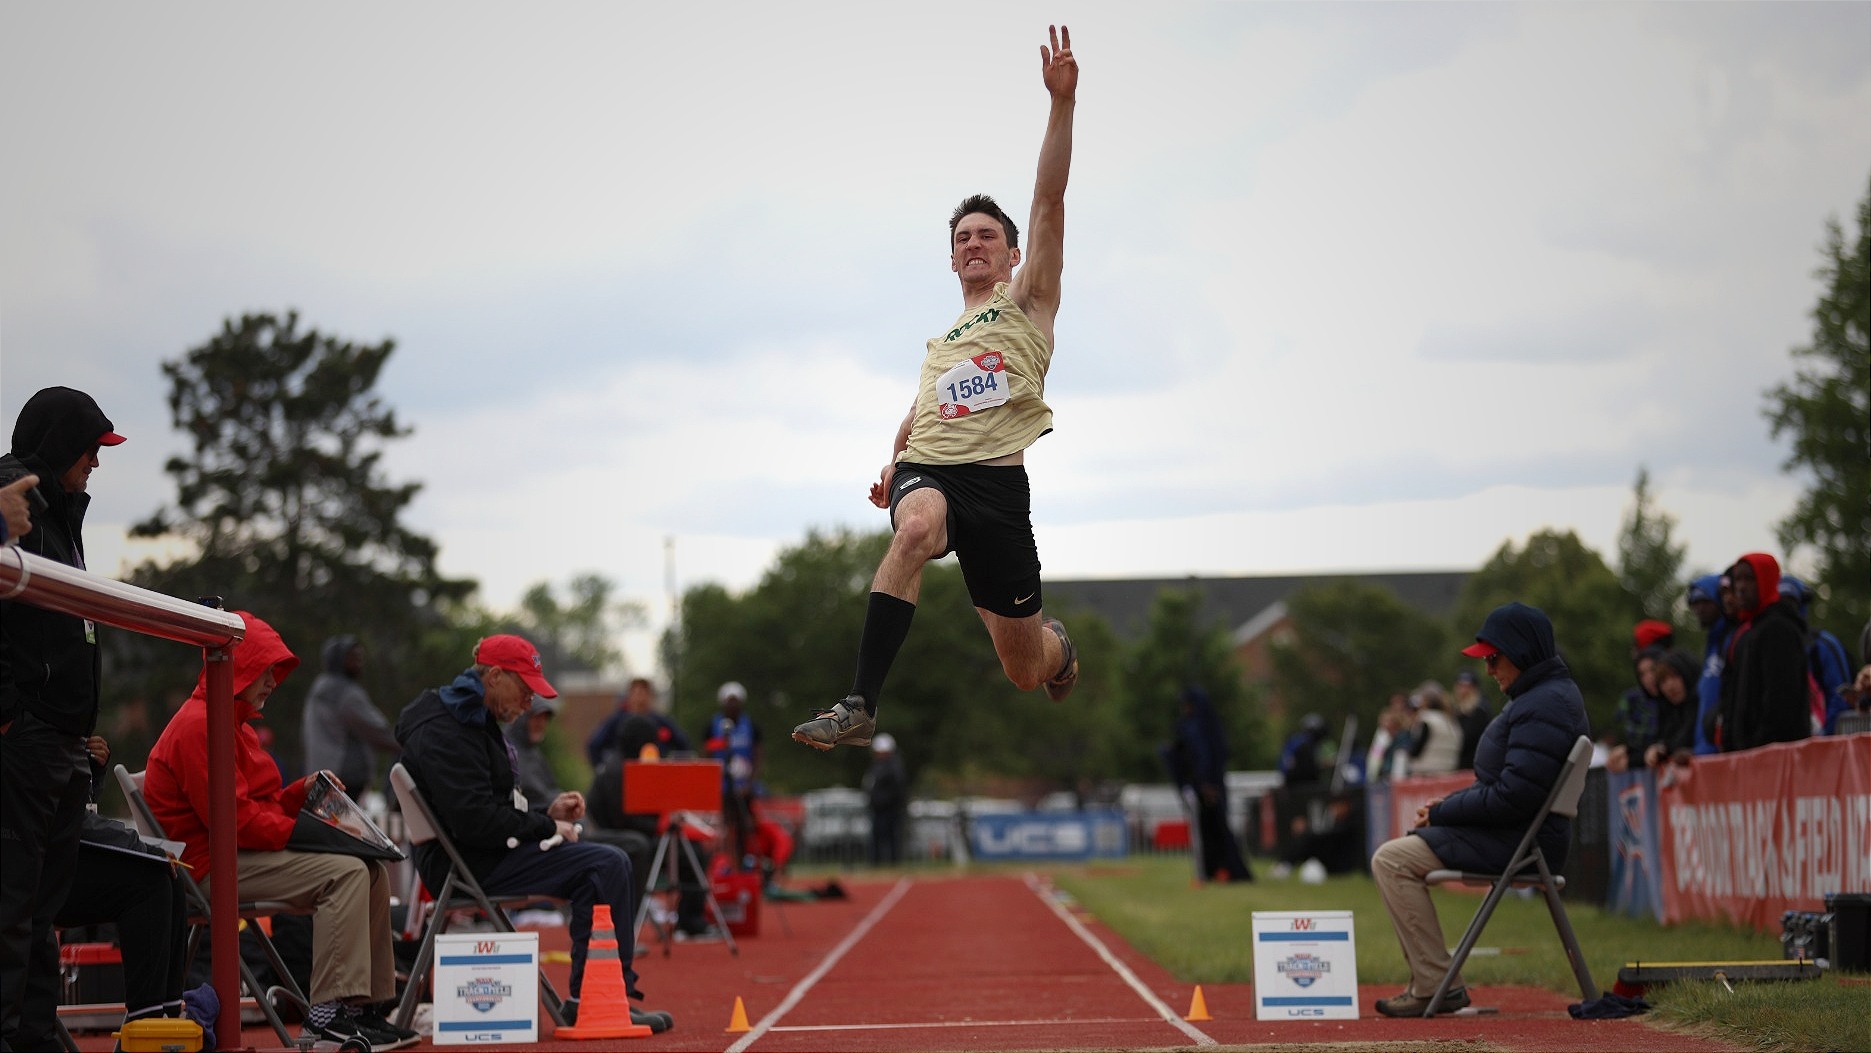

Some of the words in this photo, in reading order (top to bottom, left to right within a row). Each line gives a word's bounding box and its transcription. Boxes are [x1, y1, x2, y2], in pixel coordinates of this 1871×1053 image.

[946, 372, 997, 402] 1584
[977, 821, 1087, 854] UCS
[1728, 800, 1781, 899] TRACK
[1795, 795, 1842, 899] FIELD
[465, 1033, 503, 1041] UCS
